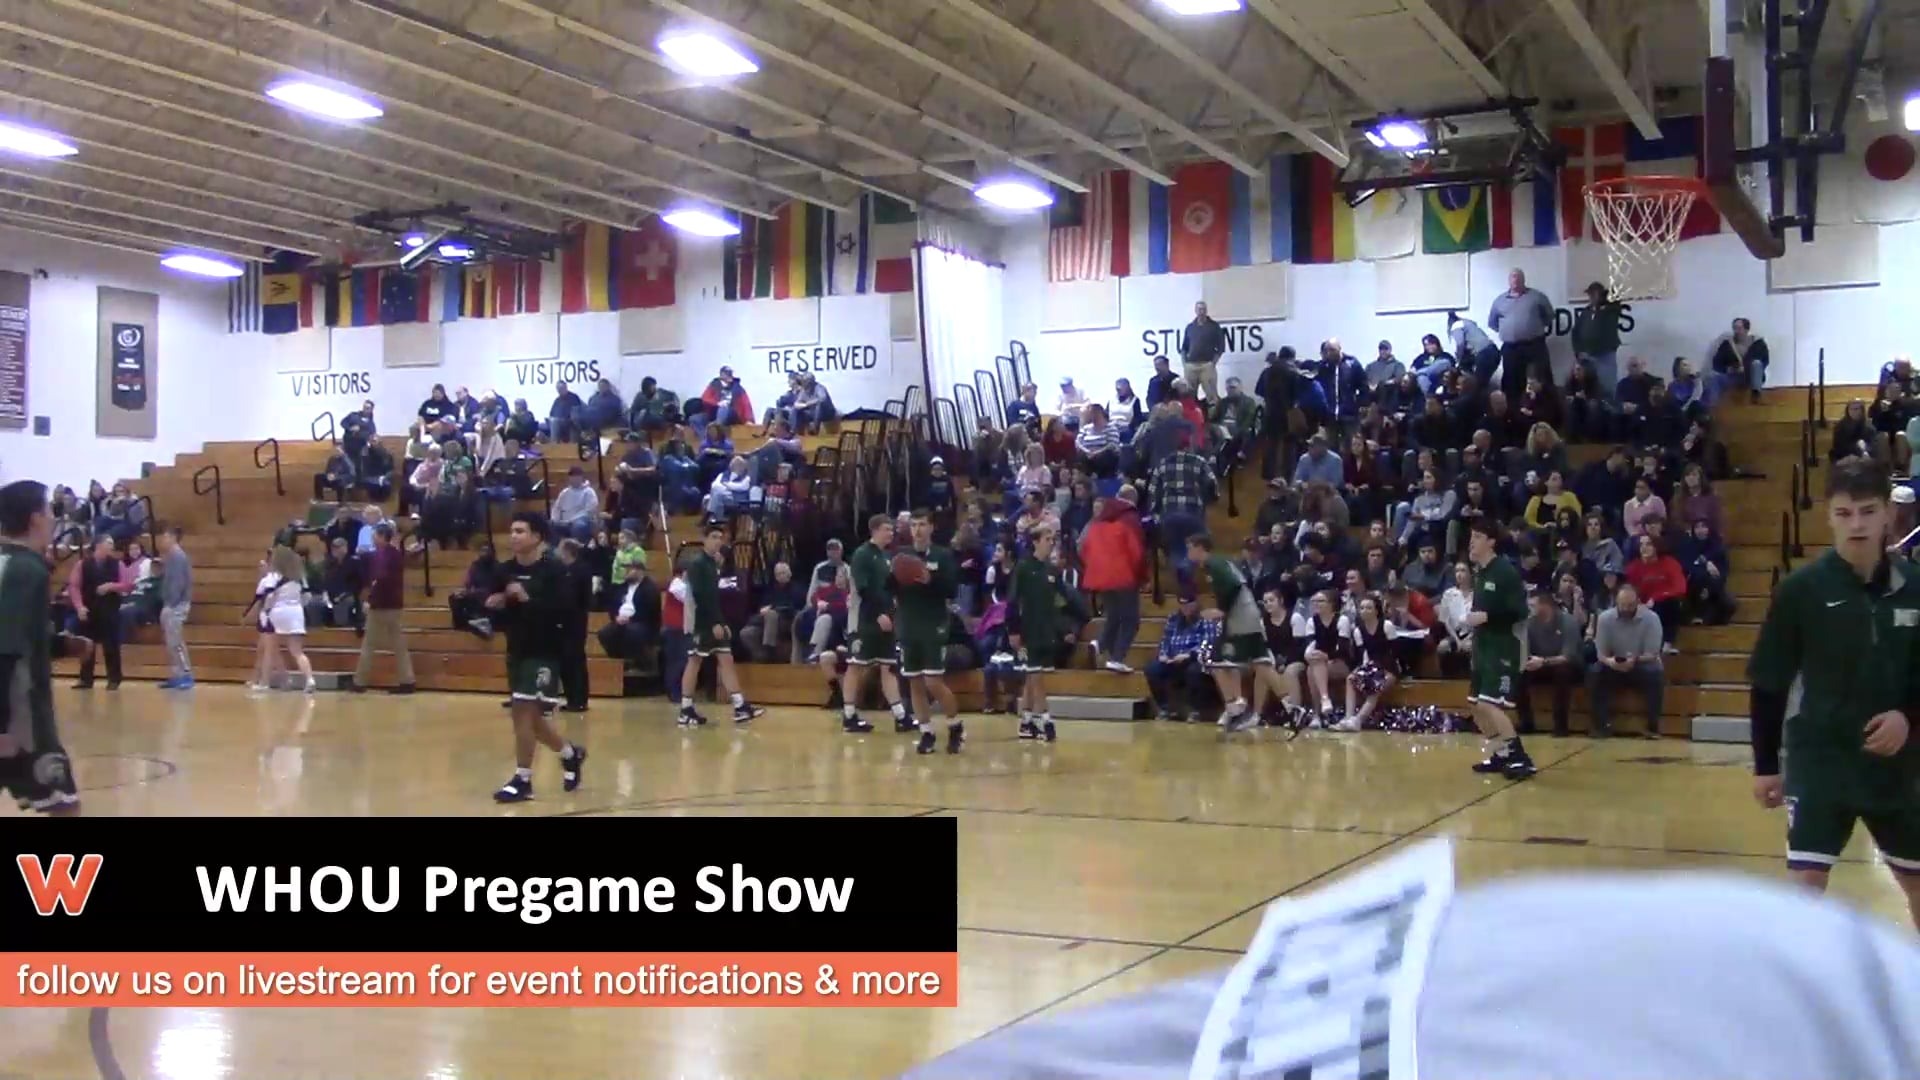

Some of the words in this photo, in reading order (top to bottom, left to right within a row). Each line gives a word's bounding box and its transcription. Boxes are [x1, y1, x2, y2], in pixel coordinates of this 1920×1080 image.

[1142, 325, 1264, 356] STNTS
[769, 345, 877, 373] RESERVED
[292, 372, 371, 396] VISITORS
[516, 360, 601, 385] VISITORS
